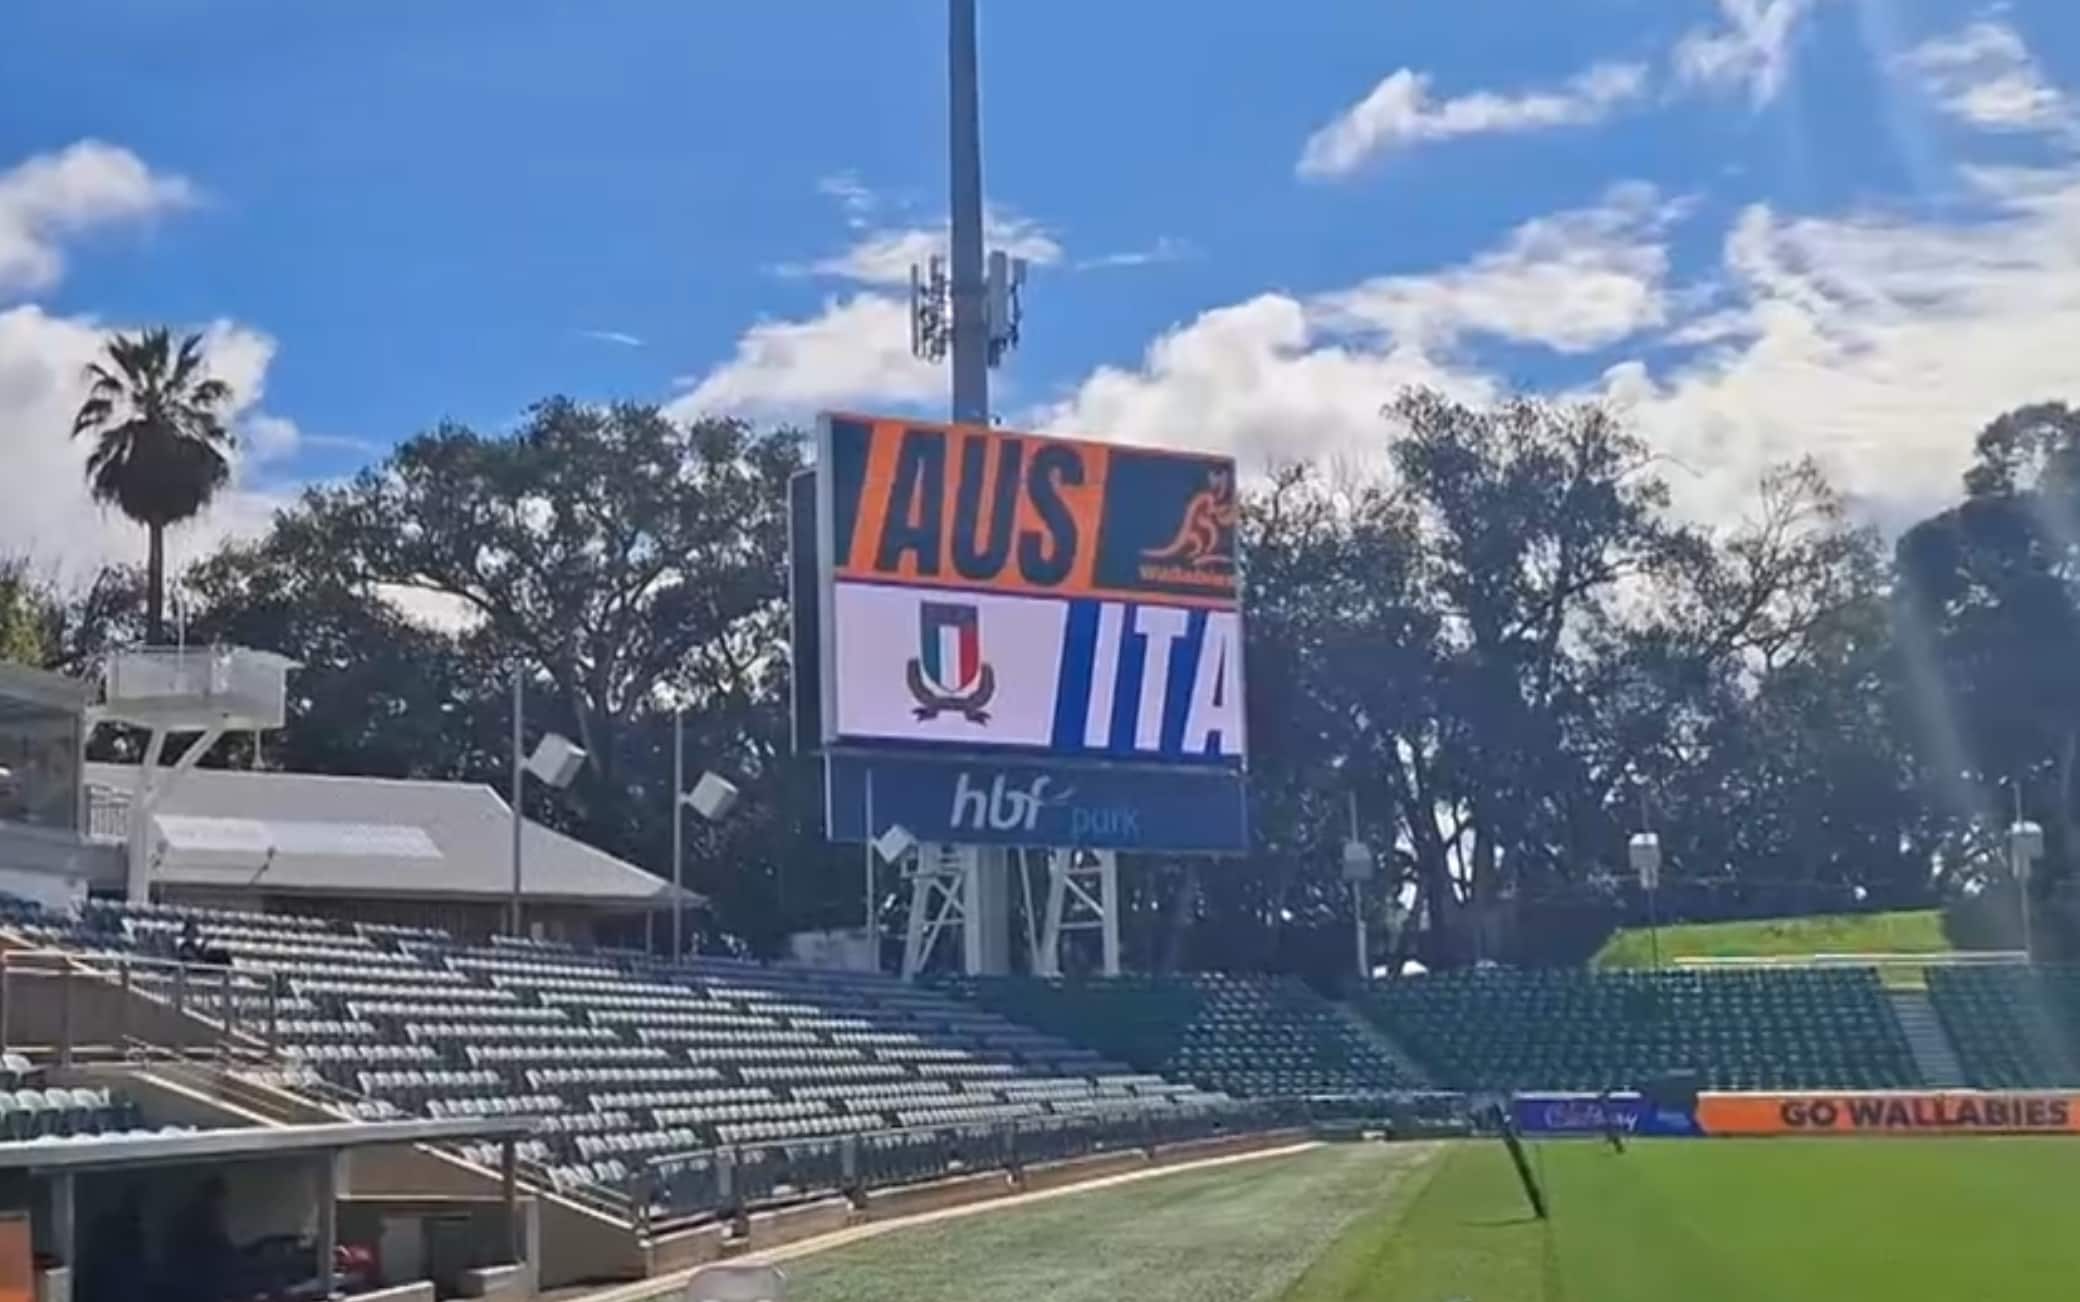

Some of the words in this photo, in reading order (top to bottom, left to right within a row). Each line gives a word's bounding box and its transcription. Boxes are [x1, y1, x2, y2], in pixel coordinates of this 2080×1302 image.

[874, 427, 1084, 586] AUS
[1083, 602, 1242, 755] ITA
[951, 773, 1070, 829] hbf
[1071, 807, 1138, 840] park
[1781, 1099, 1837, 1126] GO
[1852, 1099, 2069, 1126] WALLABIES
